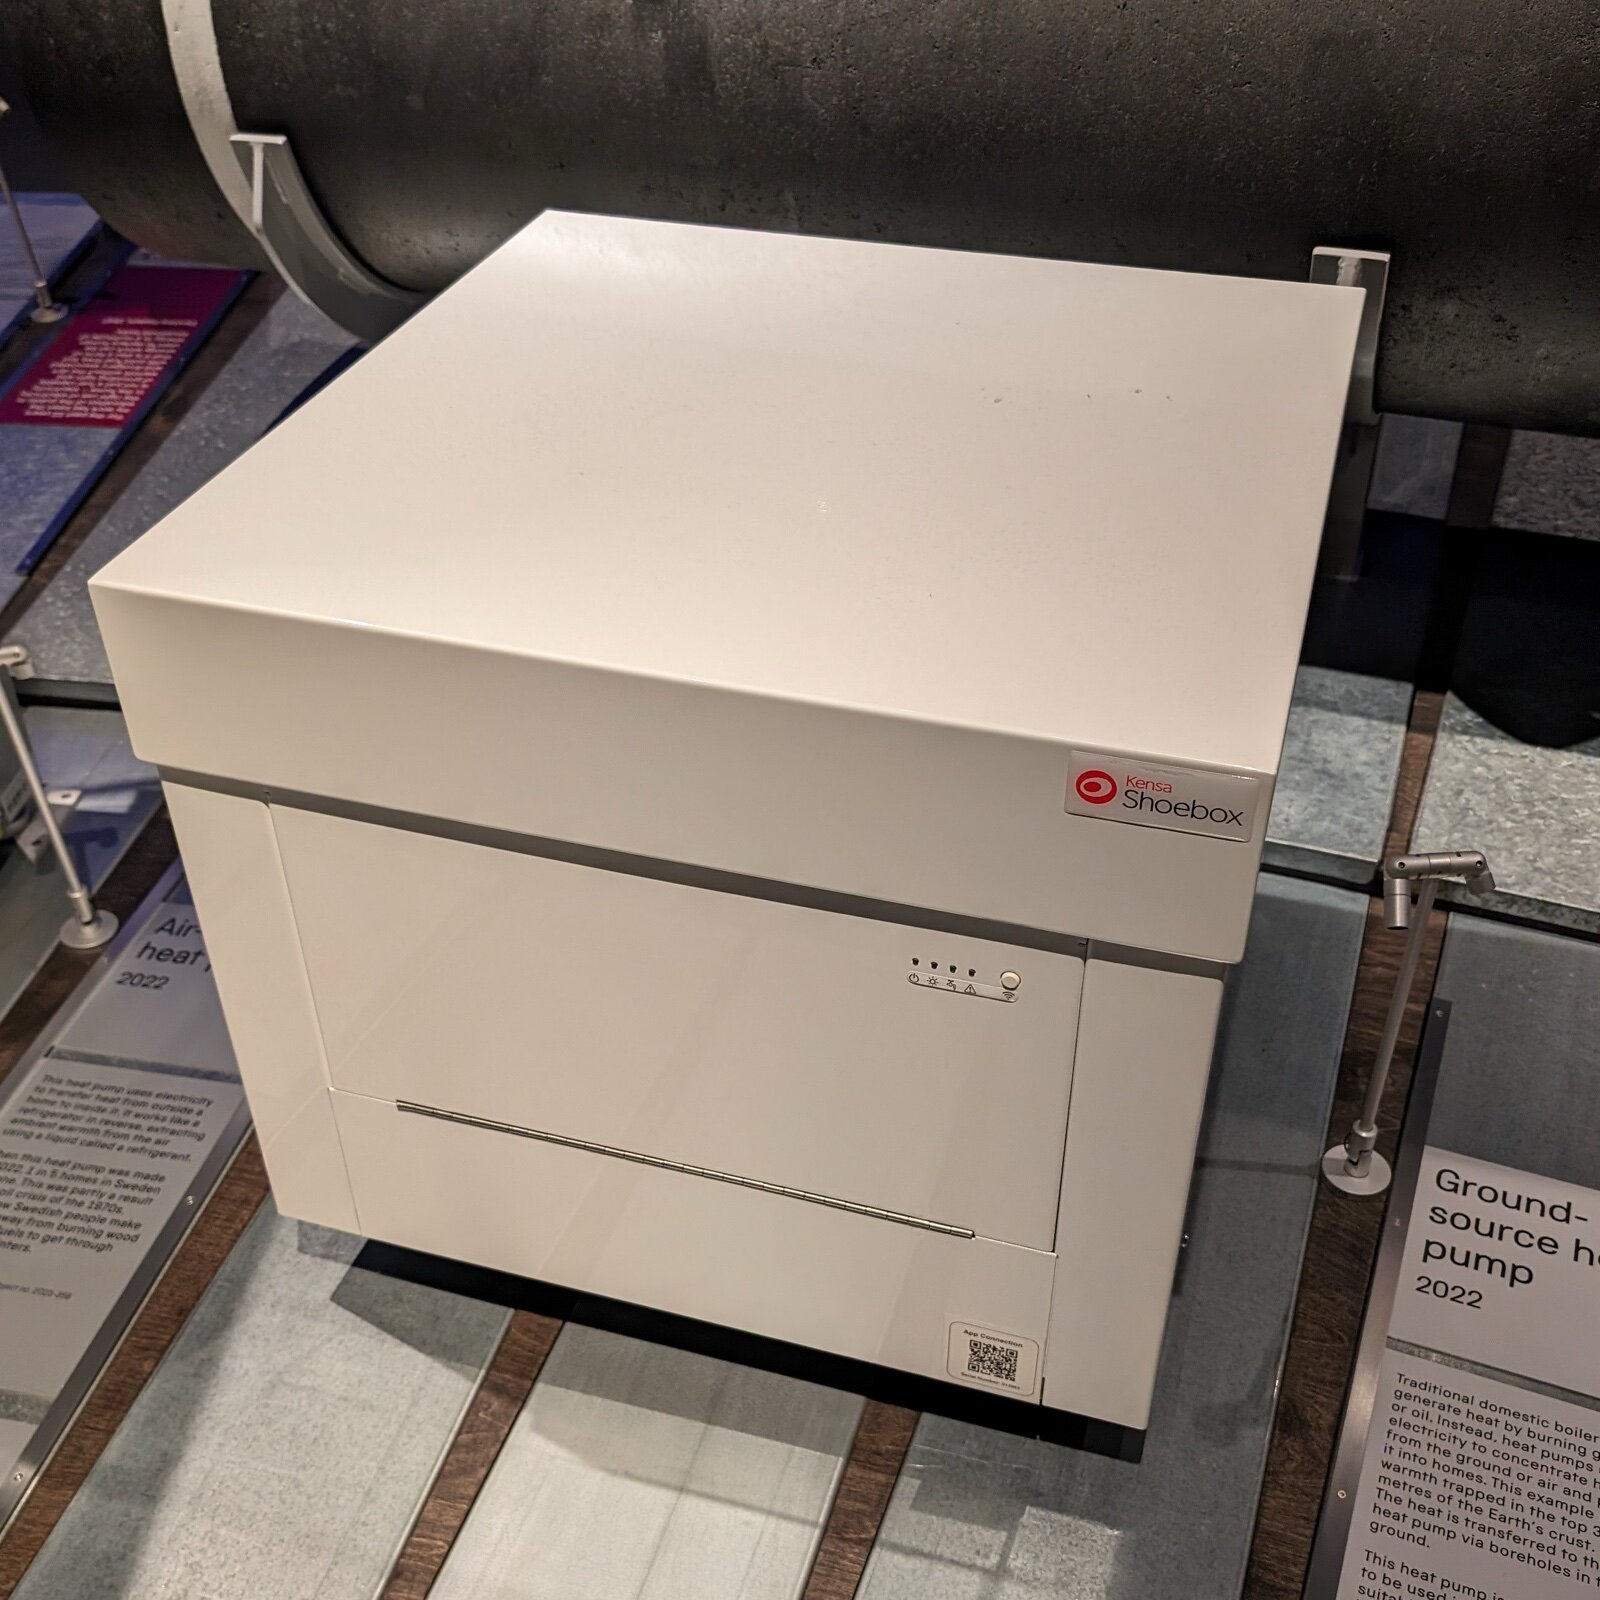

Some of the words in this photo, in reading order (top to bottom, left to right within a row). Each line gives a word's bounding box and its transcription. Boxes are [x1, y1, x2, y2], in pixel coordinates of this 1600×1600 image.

[1126, 775, 1172, 793] Kensa
[1122, 790, 1244, 826] Shoebox
[137, 941, 206, 965] heat
[116, 970, 170, 989] 2022
[65, 1078, 92, 1088] heat
[91, 1083, 125, 1094] pump
[126, 1088, 153, 1098] uses
[155, 1092, 213, 1108] electricity
[121, 1098, 149, 1108] from
[151, 1102, 194, 1114] outside
[134, 1112, 168, 1122] works
[58, 1125, 101, 1136] warmth
[102, 1129, 130, 1141] from
[132, 1134, 152, 1143] the
[147, 1126, 206, 1142] extracting
[44, 1157, 71, 1167] heat
[71, 1162, 106, 1174] pump
[108, 1168, 130, 1177] was
[132, 1170, 166, 1182] made
[59, 1171, 98, 1184] homes
[114, 1179, 161, 1194] Sweden
[46, 1183, 69, 1192] was
[68, 1186, 106, 1199] partly
[118, 1194, 154, 1206] result
[65, 1198, 85, 1207] the
[1435, 1168, 1589, 1224] Ground-
[14, 1201, 63, 1216] Swedish
[64, 1211, 108, 1224] people
[109, 1218, 142, 1229] make
[25, 1217, 55, 1229] from
[56, 1222, 104, 1239] burning
[106, 1231, 141, 1243] wood
[41, 1234, 64, 1244] get
[65, 1237, 113, 1253] through
[1429, 1205, 1559, 1255] source
[1422, 1239, 1534, 1287] pump
[1415, 1275, 1483, 1309] 2022
[963, 1329, 978, 1337] App
[980, 1333, 1023, 1348] Connection
[1397, 1372, 1474, 1405] Traditional
[1479, 1399, 1549, 1428] domestic
[1391, 1403, 1407, 1413] or
[1412, 1409, 1433, 1423] oil.
[1437, 1414, 1497, 1443] Instead,
[1502, 1434, 1537, 1453] heat
[1541, 1449, 1594, 1472] pumps
[1394, 1389, 1461, 1415] generate
[1466, 1408, 1501, 1428] heat
[1504, 1420, 1522, 1436] by
[1527, 1427, 1587, 1457] burning
[1386, 1429, 1421, 1448] from
[1427, 1442, 1451, 1457] the
[1456, 1453, 1511, 1477] ground
[1516, 1472, 1533, 1483] or
[1537, 1479, 1558, 1491] air
[1563, 1487, 1592, 1502] and
[1389, 1417, 1467, 1449] electricity
[1472, 1441, 1487, 1453] to
[1492, 1449, 1588, 1485] concentrate
[1384, 1442, 1394, 1455] it
[1398, 1447, 1427, 1465] into
[1432, 1458, 1487, 1486] homes.
[1491, 1476, 1522, 1496] This
[1527, 1491, 1594, 1519] example
[1381, 1459, 1437, 1485] warmth
[1443, 1478, 1506, 1506] trapped
[1511, 1499, 1524, 1512] in
[1530, 1506, 1556, 1522] the
[1561, 1516, 1588, 1534] top
[1376, 1486, 1403, 1505] The
[1407, 1498, 1443, 1518] heat
[1447, 1510, 1459, 1524] is
[1464, 1517, 1556, 1556] transferred
[1562, 1549, 1578, 1562] to
[1378, 1475, 1432, 1499] metres
[1437, 1494, 1454, 1505] of
[1458, 1499, 1483, 1515] the
[1488, 1508, 1544, 1535] Earth's
[1549, 1530, 1595, 1552] crust.
[1369, 1521, 1430, 1548] ground.
[1372, 1502, 1408, 1523] heat
[1411, 1518, 1457, 1540] pump
[1462, 1534, 1484, 1549] via
[1489, 1541, 1571, 1578] boreholes
[1576, 1569, 1590, 1584] in
[1361, 1567, 1377, 1580] to
[1382, 1573, 1402, 1589] be
[1364, 1549, 1395, 1570] This
[1400, 1562, 1437, 1583] heat
[1440, 1578, 1487, 1600] pump
